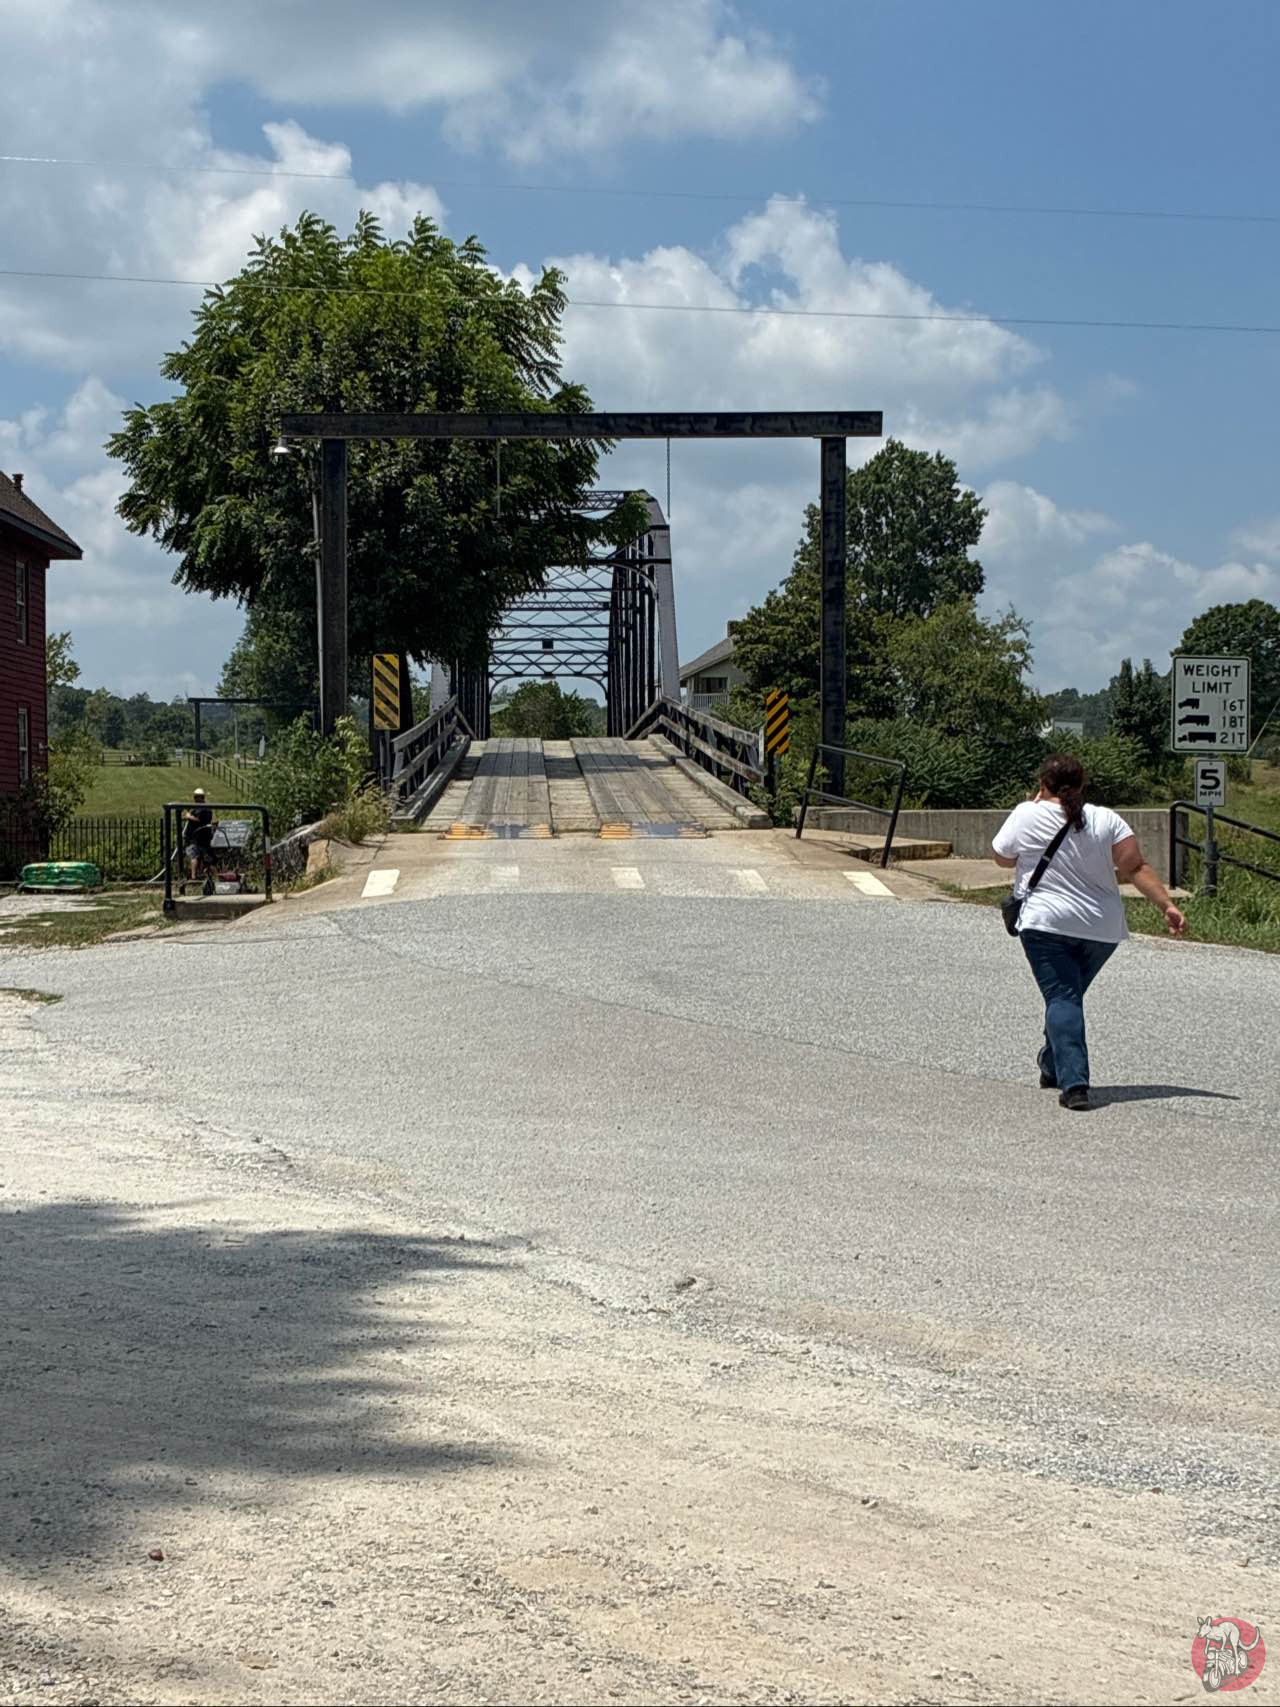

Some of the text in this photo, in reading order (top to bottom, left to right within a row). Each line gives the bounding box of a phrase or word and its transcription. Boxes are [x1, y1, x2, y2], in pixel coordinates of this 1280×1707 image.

[1183, 664, 1241, 677] WEIGHT
[1192, 681, 1232, 694] LIMIT
[1223, 699, 1245, 712] 16T
[1222, 715, 1245, 728] 18T
[1220, 732, 1246, 745] 21T
[1200, 768, 1220, 790] 5
